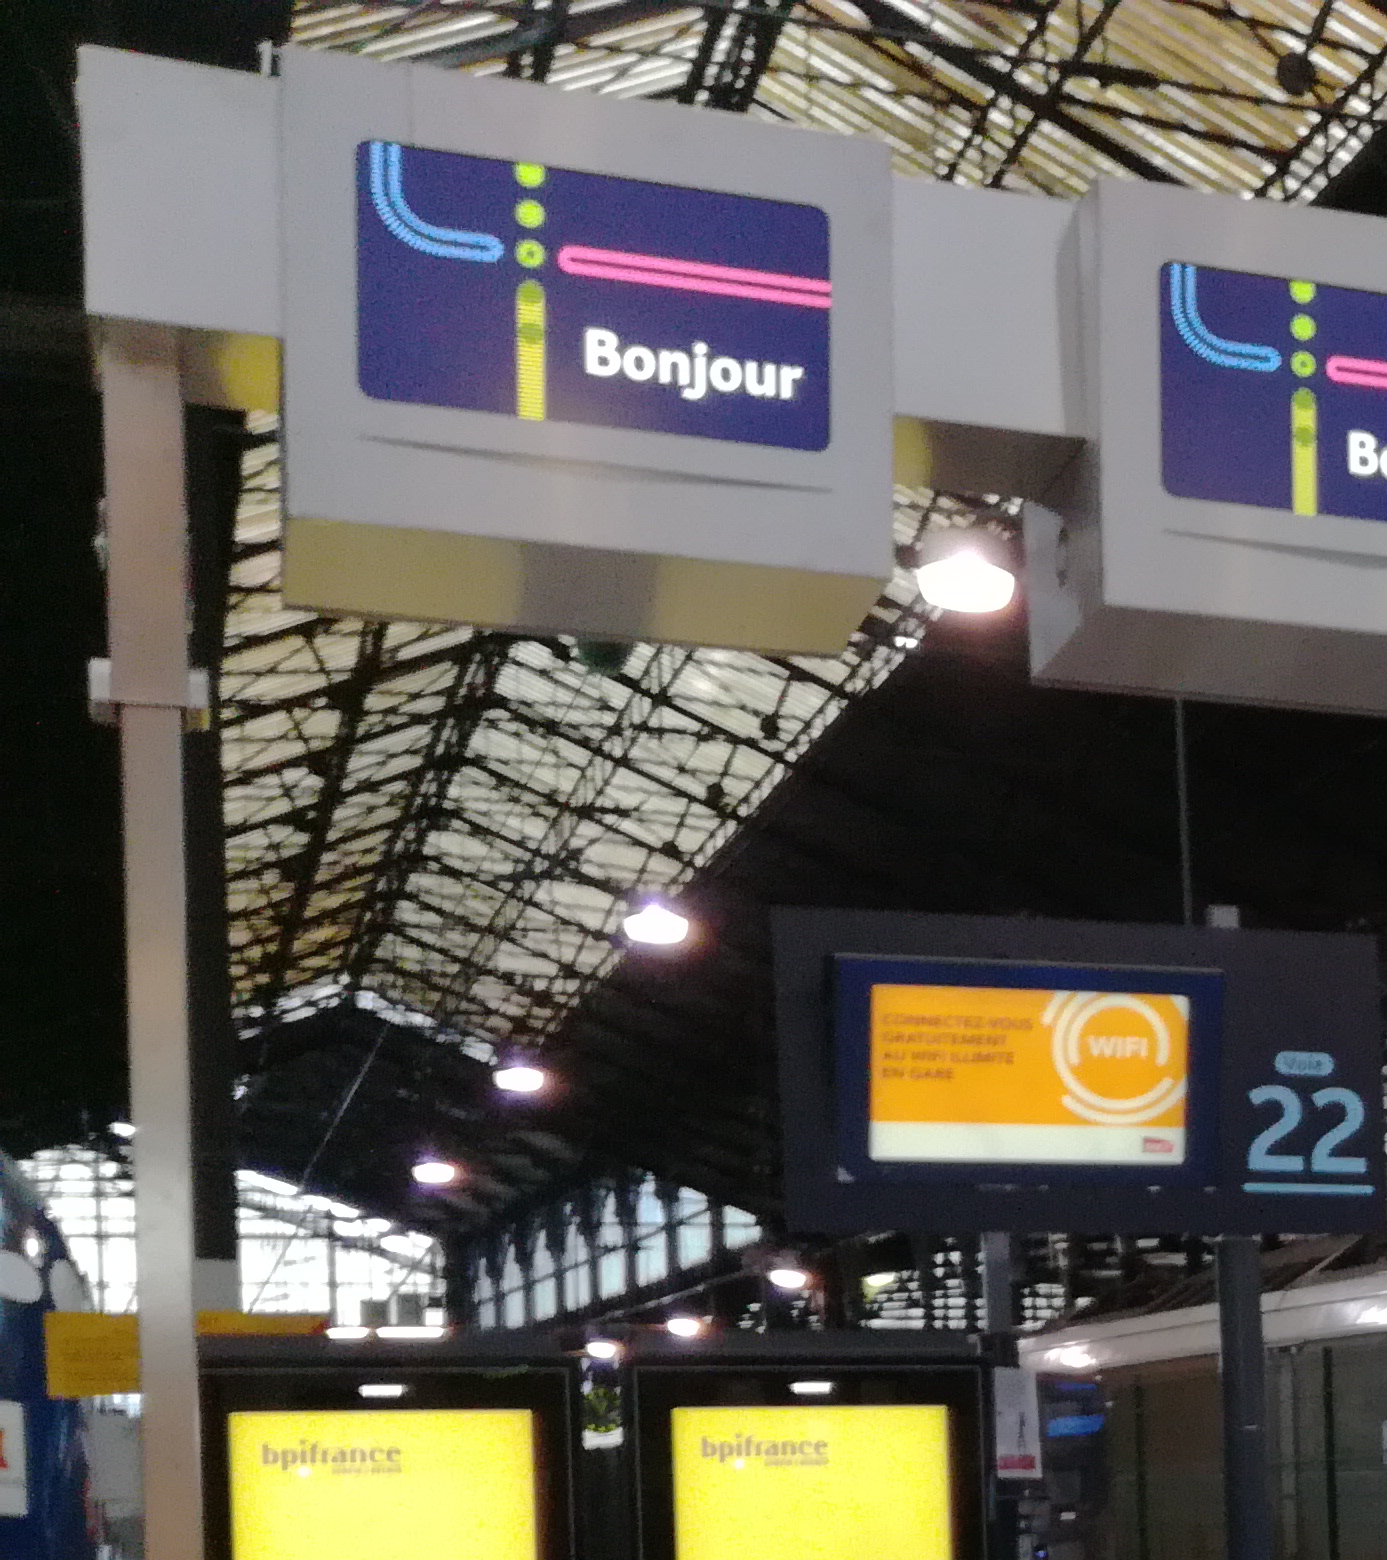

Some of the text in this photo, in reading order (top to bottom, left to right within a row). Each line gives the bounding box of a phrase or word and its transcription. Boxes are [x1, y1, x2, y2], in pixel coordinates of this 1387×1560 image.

[584, 327, 804, 400] Bonjour
[1088, 1036, 1148, 1058] WIFI
[1249, 1084, 1368, 1173] 22
[262, 1439, 402, 1471] bpifrance
[702, 1432, 830, 1463] bpifrance
